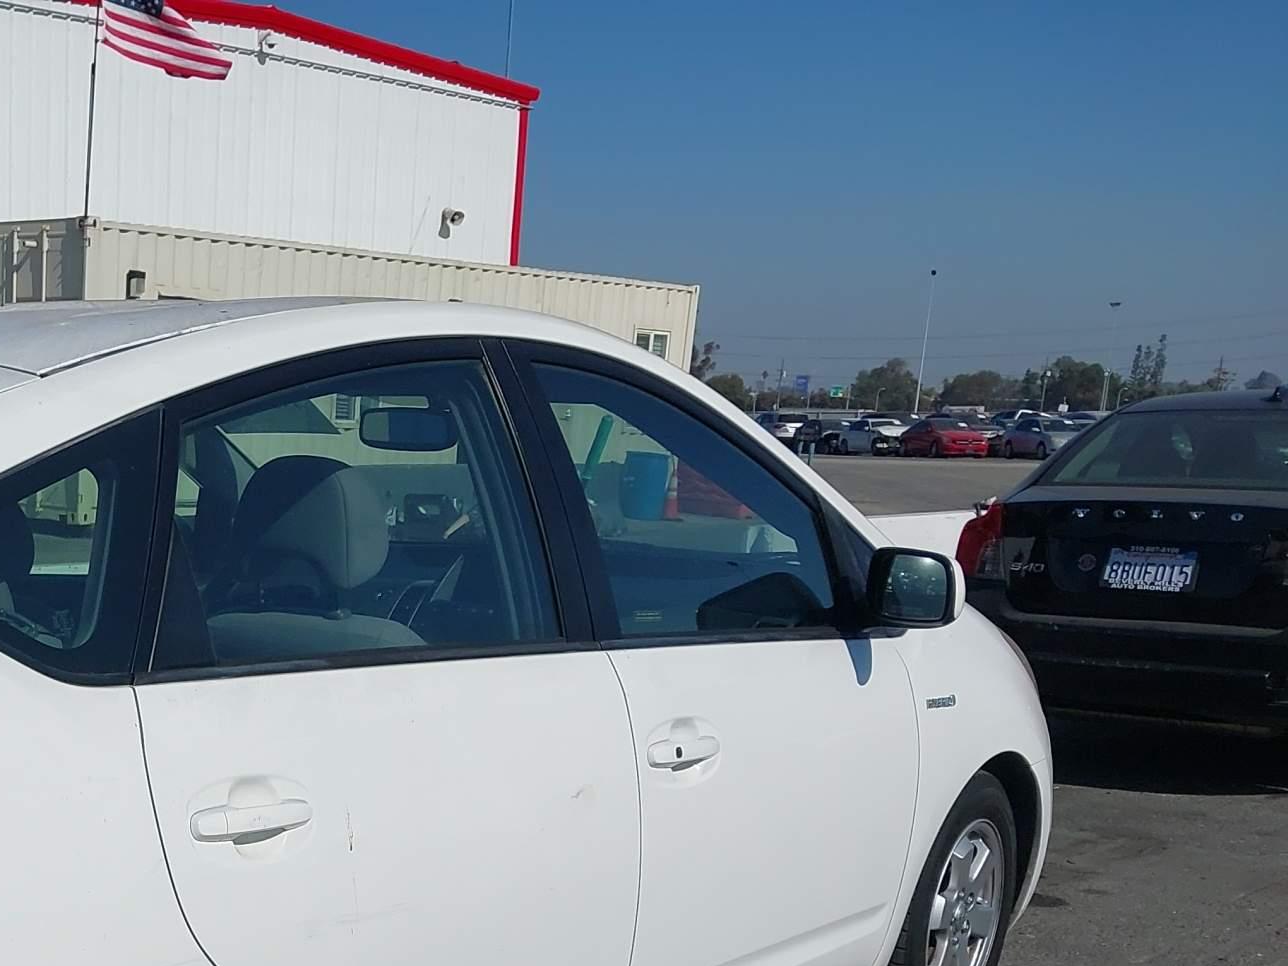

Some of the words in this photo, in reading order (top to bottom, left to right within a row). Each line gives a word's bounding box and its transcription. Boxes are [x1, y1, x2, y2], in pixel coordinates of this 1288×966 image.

[1072, 508, 1245, 522] VOLVO
[1010, 562, 1045, 573] S40
[1109, 577, 1151, 586] BEVERLY
[1155, 580, 1184, 588] HILLS
[1137, 584, 1181, 592] BROKERS
